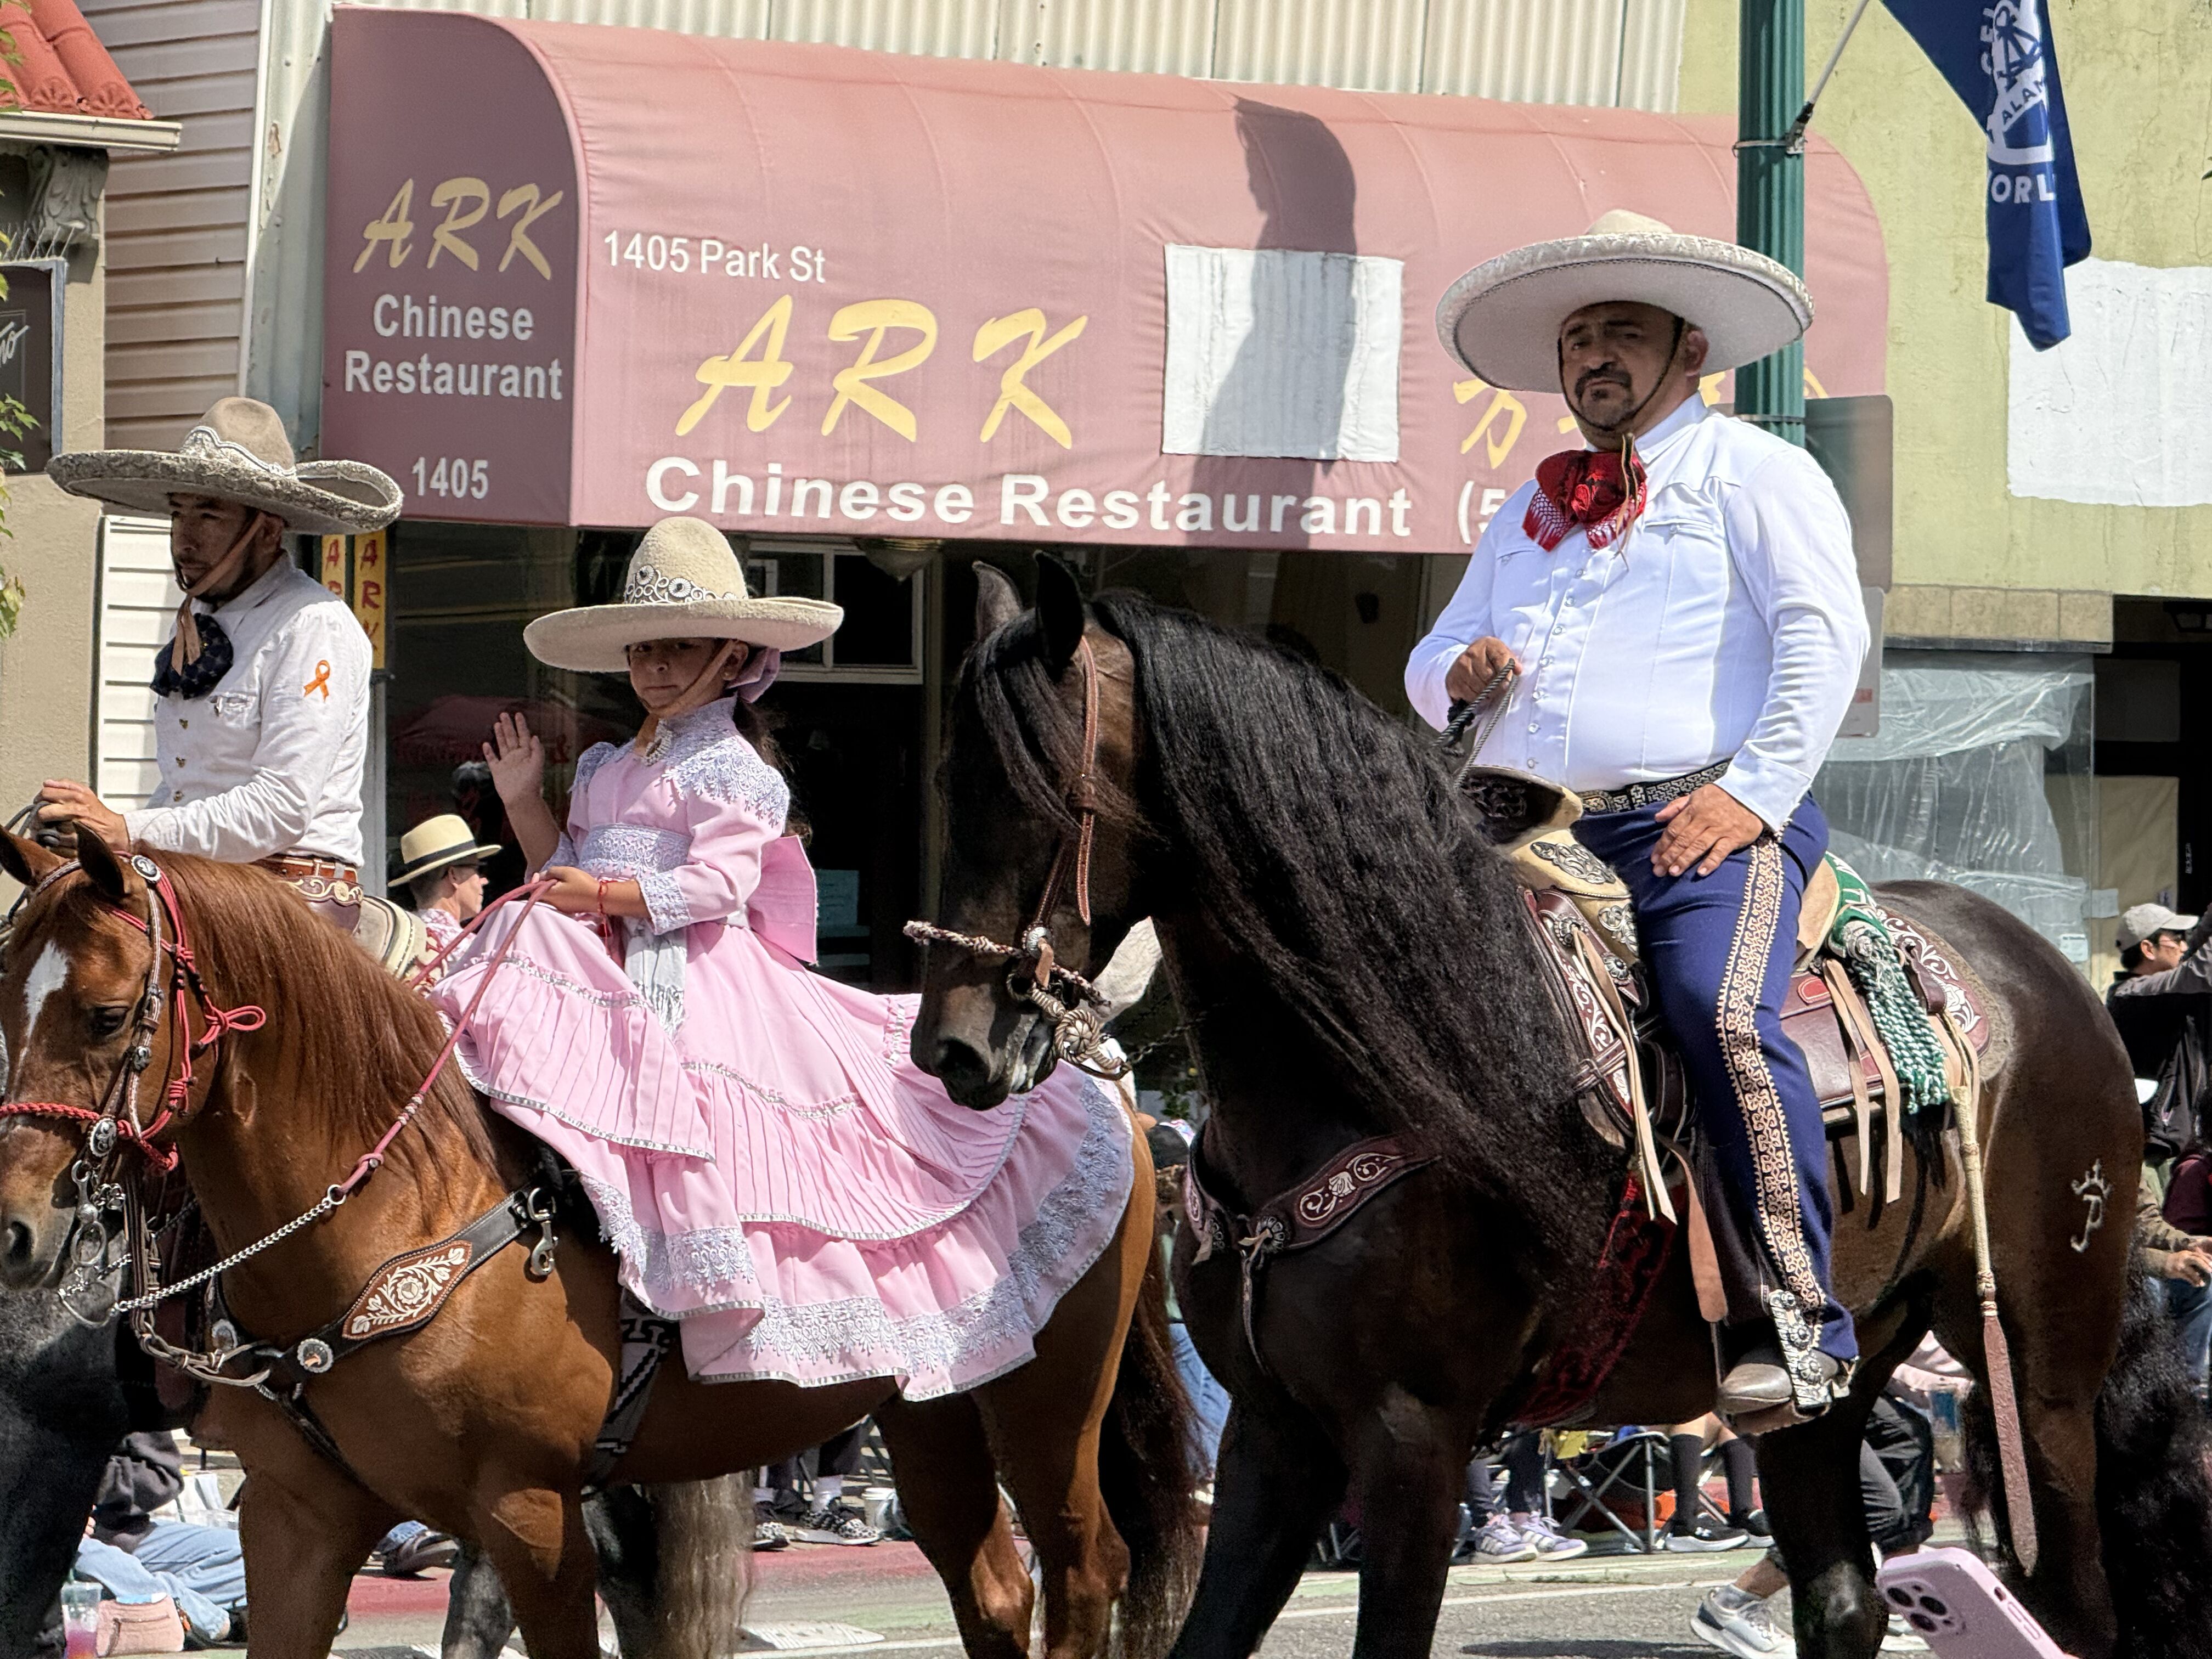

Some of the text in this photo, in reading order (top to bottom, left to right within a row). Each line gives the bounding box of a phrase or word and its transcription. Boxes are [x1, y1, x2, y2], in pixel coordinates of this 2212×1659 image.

[1988, 170, 2056, 204] ORL
[353, 177, 563, 280] ARK
[604, 230, 826, 283] 1405 Park St
[374, 294, 534, 341] Chinese
[345, 350, 563, 400] Restaurant
[675, 294, 1088, 449] ARK
[412, 456, 489, 499] 1405
[646, 456, 974, 523] Chinese
[1000, 473, 1412, 537] Restaurant
